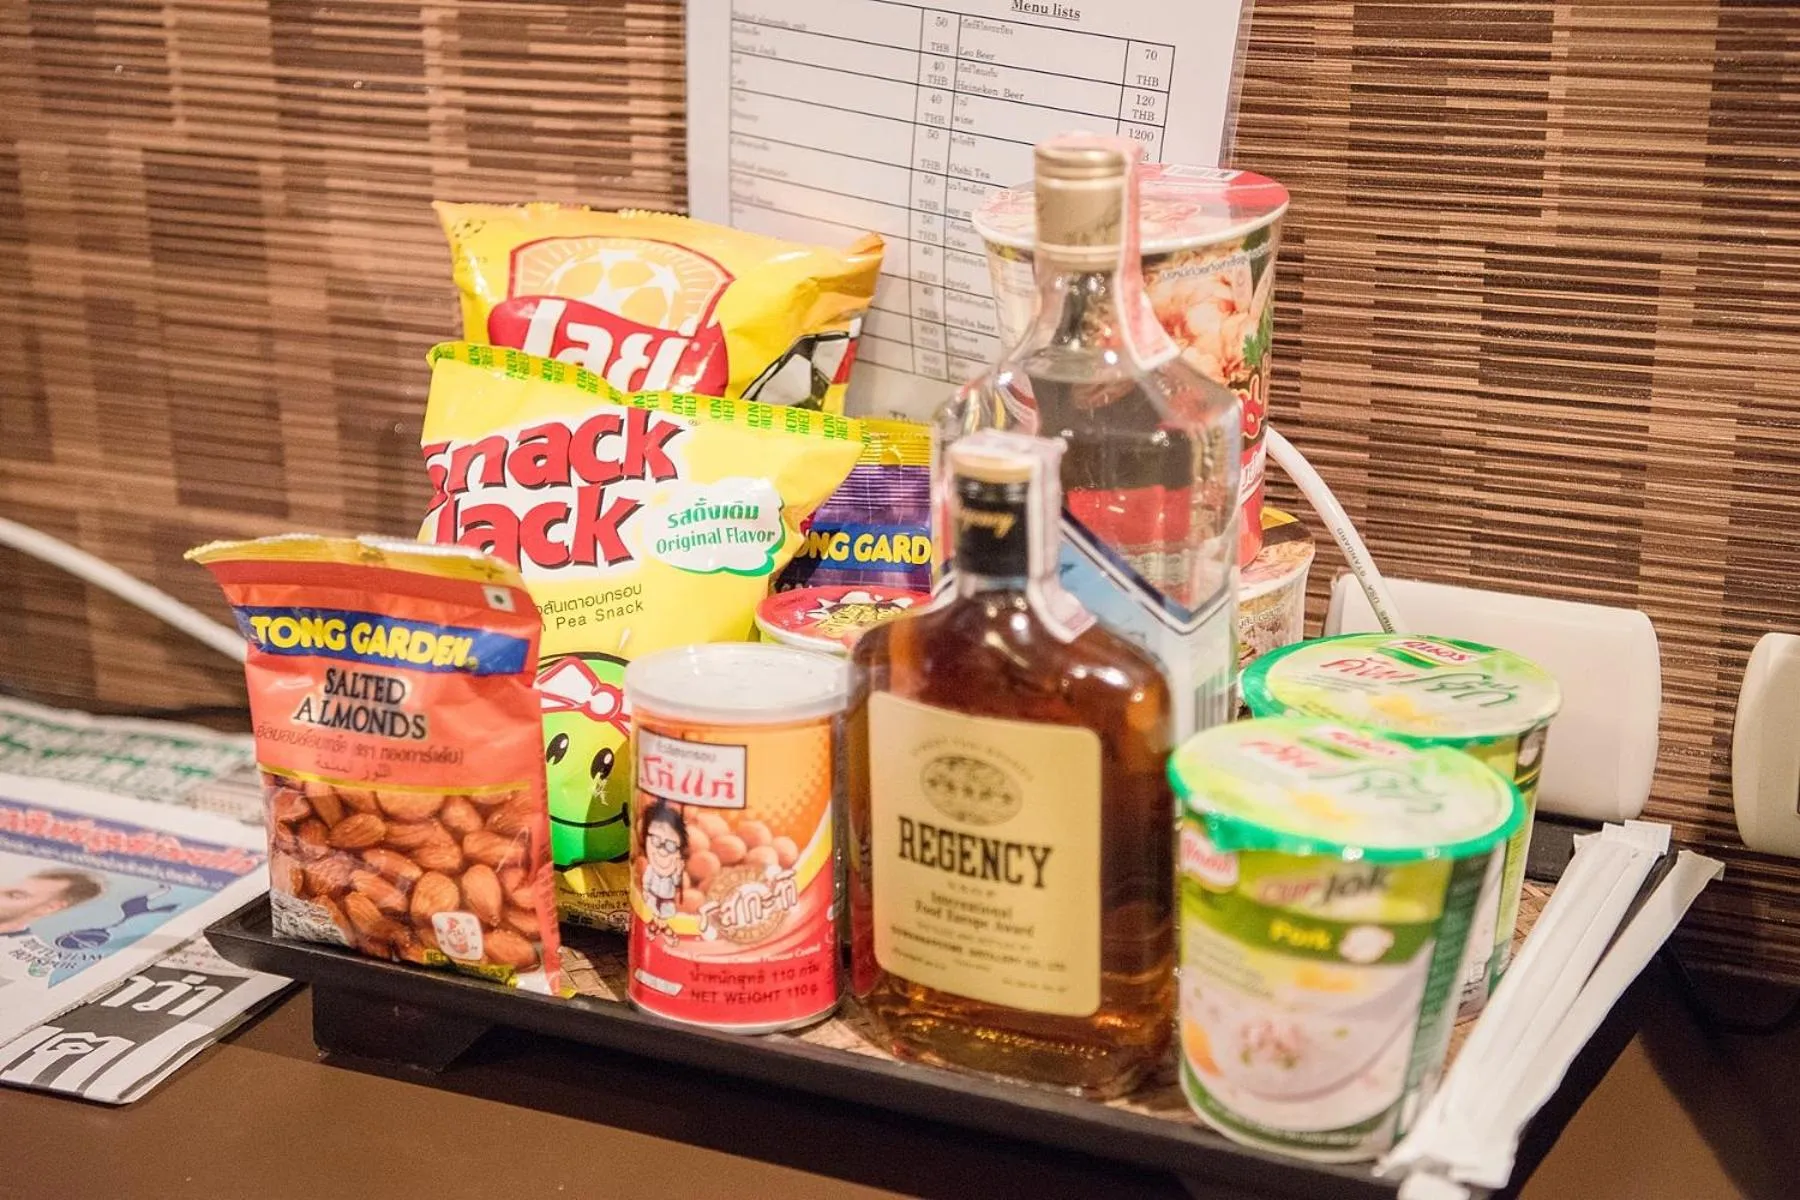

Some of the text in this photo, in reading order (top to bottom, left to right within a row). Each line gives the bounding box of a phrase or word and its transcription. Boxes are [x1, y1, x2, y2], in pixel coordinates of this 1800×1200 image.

[1011, 0, 1081, 19] Menu lists
[1144, 48, 1158, 61] 70
[927, 74, 948, 87] THB
[1136, 75, 1159, 88] THB
[1003, 87, 1025, 101] Beer
[1135, 93, 1155, 107] 120
[1132, 108, 1155, 122] THB
[1128, 128, 1155, 142] 1200
[422, 407, 685, 513] Snack
[656, 526, 776, 554] Original Flavor
[853, 533, 932, 565] GARD
[556, 600, 644, 630] Pea Snack
[251, 616, 474, 668] TONG GARDEN
[324, 667, 406, 705] SALTED
[293, 696, 427, 740] ALMONDS
[898, 815, 1054, 889] REGENCY
[691, 989, 718, 1004] NET
[724, 989, 781, 1006] WEIGHT
